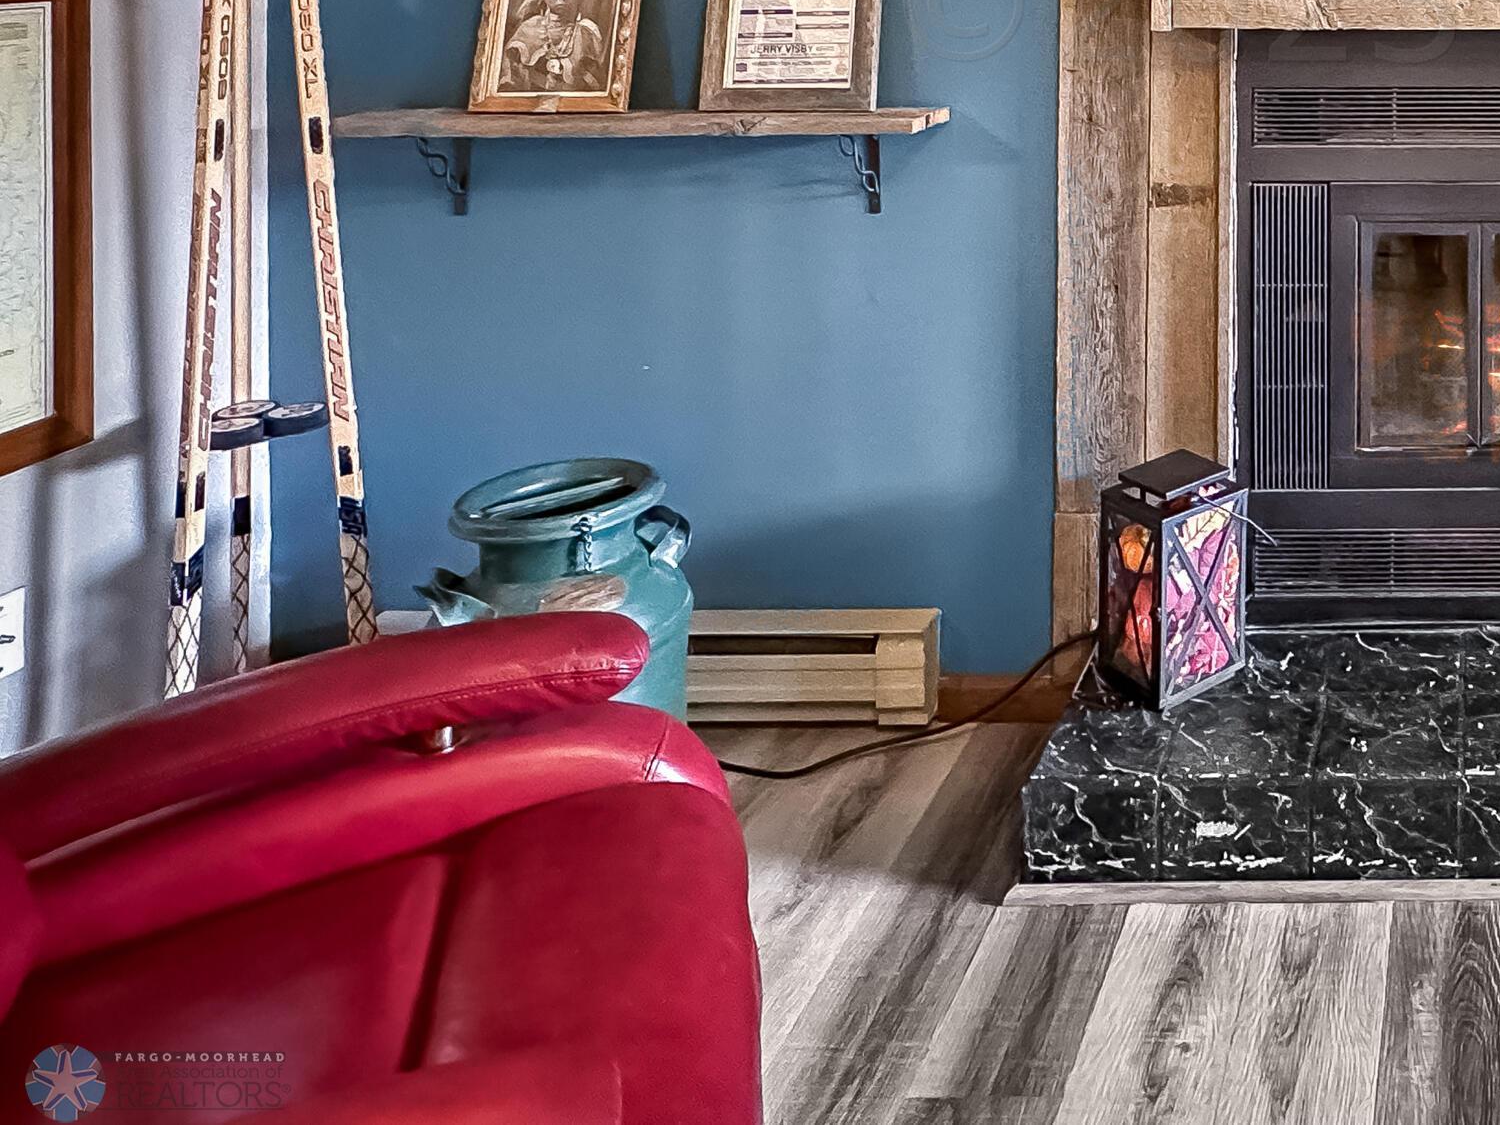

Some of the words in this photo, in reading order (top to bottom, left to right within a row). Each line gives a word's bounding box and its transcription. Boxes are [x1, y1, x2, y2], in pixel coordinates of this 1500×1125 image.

[750, 44, 782, 54] JERRY
[785, 43, 814, 54] VISBY
[198, 188, 222, 452] CHRISTIAN
[303, 57, 318, 99] XL
[313, 178, 351, 422] CHRISTIAN
